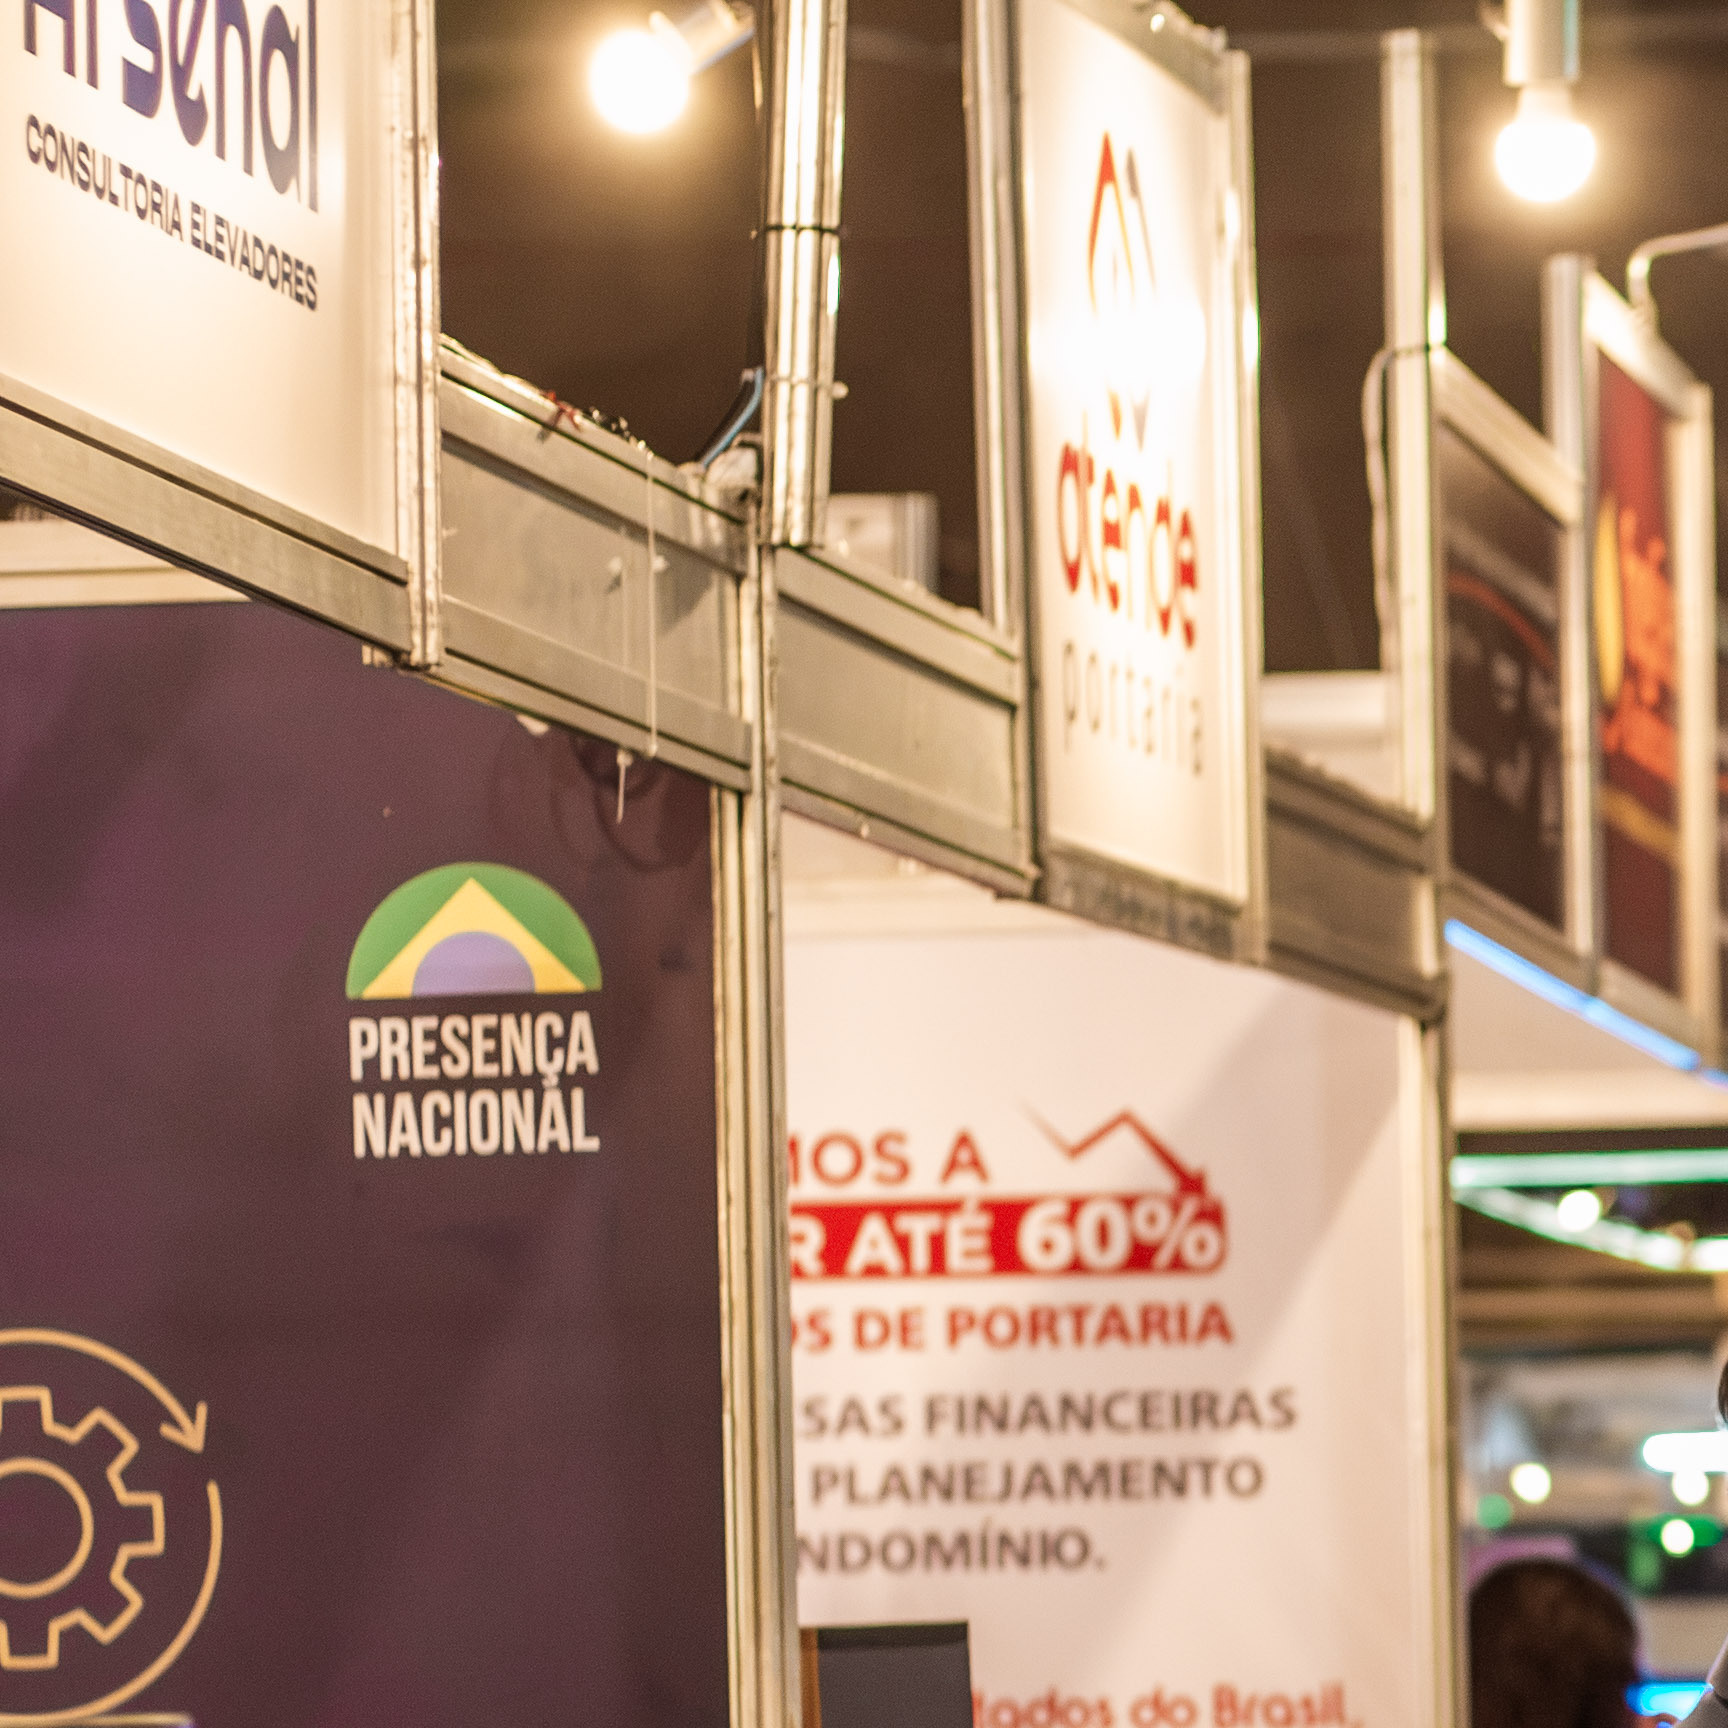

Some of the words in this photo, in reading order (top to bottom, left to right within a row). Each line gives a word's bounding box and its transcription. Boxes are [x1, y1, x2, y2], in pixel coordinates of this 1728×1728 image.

[24, 0, 318, 213] senal
[26, 113, 184, 242] CONSULTORIA
[190, 200, 318, 312] ELEVADORES
[1057, 442, 1199, 652] atende
[349, 1010, 600, 1087] PRESENÇA
[352, 1087, 601, 1160] NACIONAL
[788, 1129, 912, 1188] OS
[940, 1128, 990, 1186] A
[846, 1199, 994, 1275] ATÉ
[1015, 1196, 1222, 1273] 60%
[791, 1308, 832, 1354] S
[854, 1307, 926, 1350] DE
[948, 1301, 1234, 1350] PORTARIA
[923, 1388, 1298, 1436] FINANCEIRAS
[812, 1457, 1265, 1508] PLANEJAMENTO
